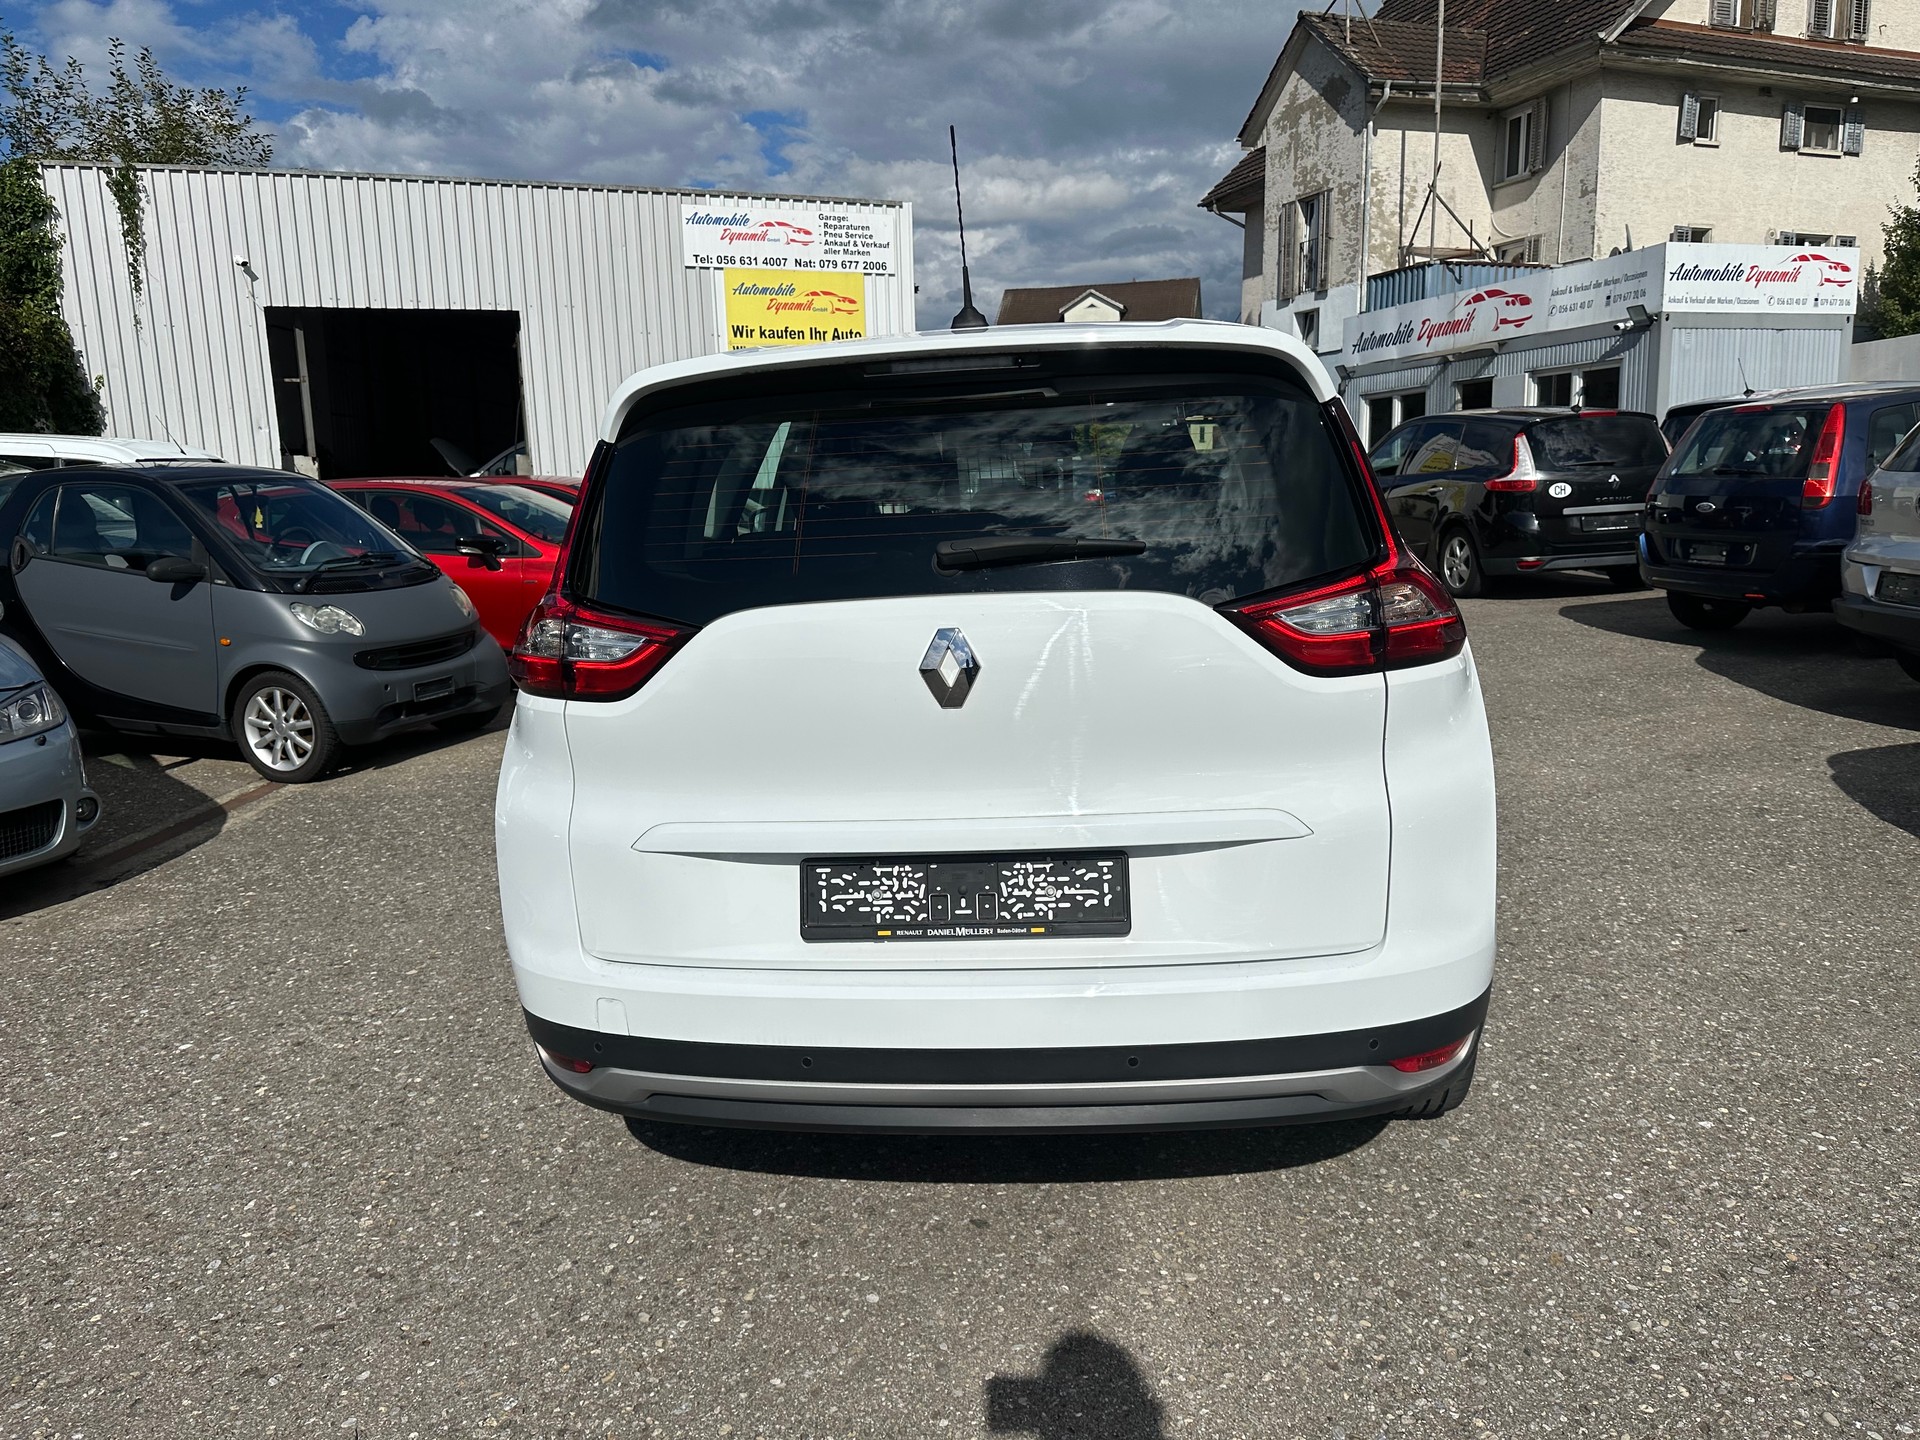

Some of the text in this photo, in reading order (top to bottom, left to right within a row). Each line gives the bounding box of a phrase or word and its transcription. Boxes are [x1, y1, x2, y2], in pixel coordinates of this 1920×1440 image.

[685, 212, 750, 227] Automobile
[818, 213, 849, 223] Garage:
[823, 222, 870, 231] Reparaturen
[720, 228, 768, 245] Dynamik
[845, 232, 874, 240] Service
[824, 239, 851, 247] Ankauf
[860, 240, 890, 249] Verkauf
[843, 248, 871, 256] Marken
[693, 254, 887, 271] Tel: 056 631 4007 Nat: 079 677 2006
[1669, 263, 1803, 289] Automobile Dynamik
[732, 282, 796, 296] Automobile
[1573, 281, 1593, 293] Verkauf
[1612, 293, 1622, 304] 079
[1622, 291, 1632, 302] 677
[1639, 288, 1646, 298] 06
[766, 298, 814, 315] Dynamik
[1558, 300, 1594, 313] 056 631 40 07
[731, 325, 862, 341] Wir kaufen Ihr Auto
[1352, 308, 1476, 355] Automobile Dynamik
[1554, 485, 1566, 496] CH
